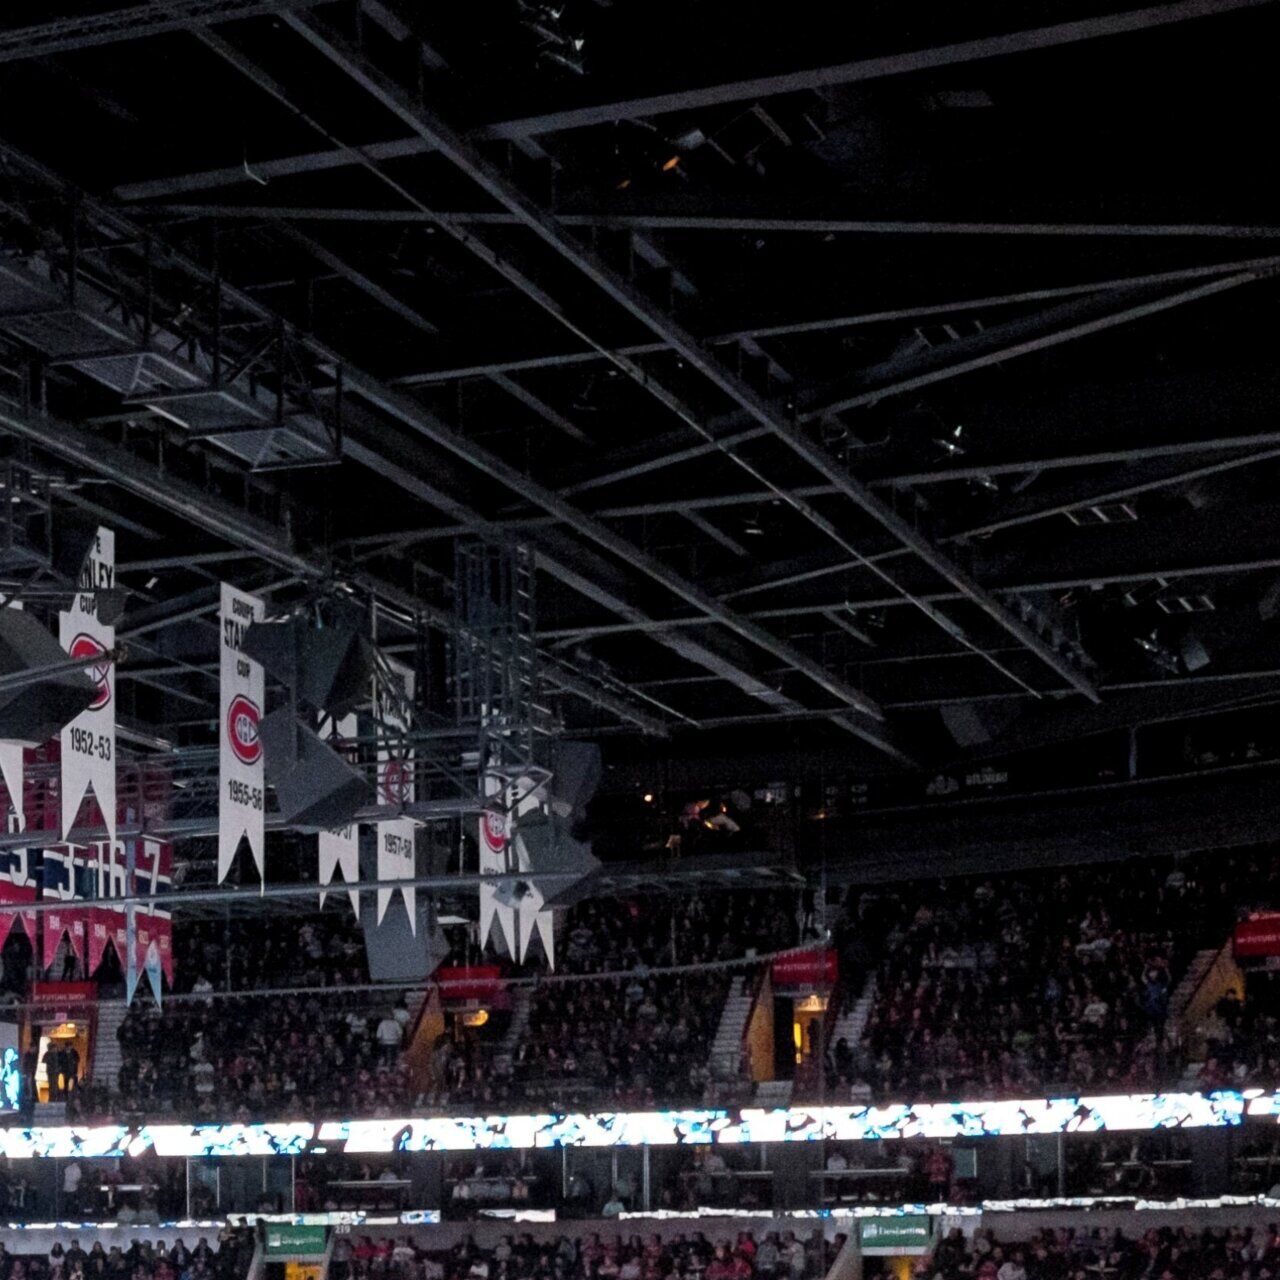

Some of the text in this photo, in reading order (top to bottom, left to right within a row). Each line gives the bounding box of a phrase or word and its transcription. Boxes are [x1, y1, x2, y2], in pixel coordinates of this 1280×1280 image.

[236, 660, 251, 677] CUP
[69, 725, 113, 761] 1952-53
[228, 778, 263, 810] 1955-56
